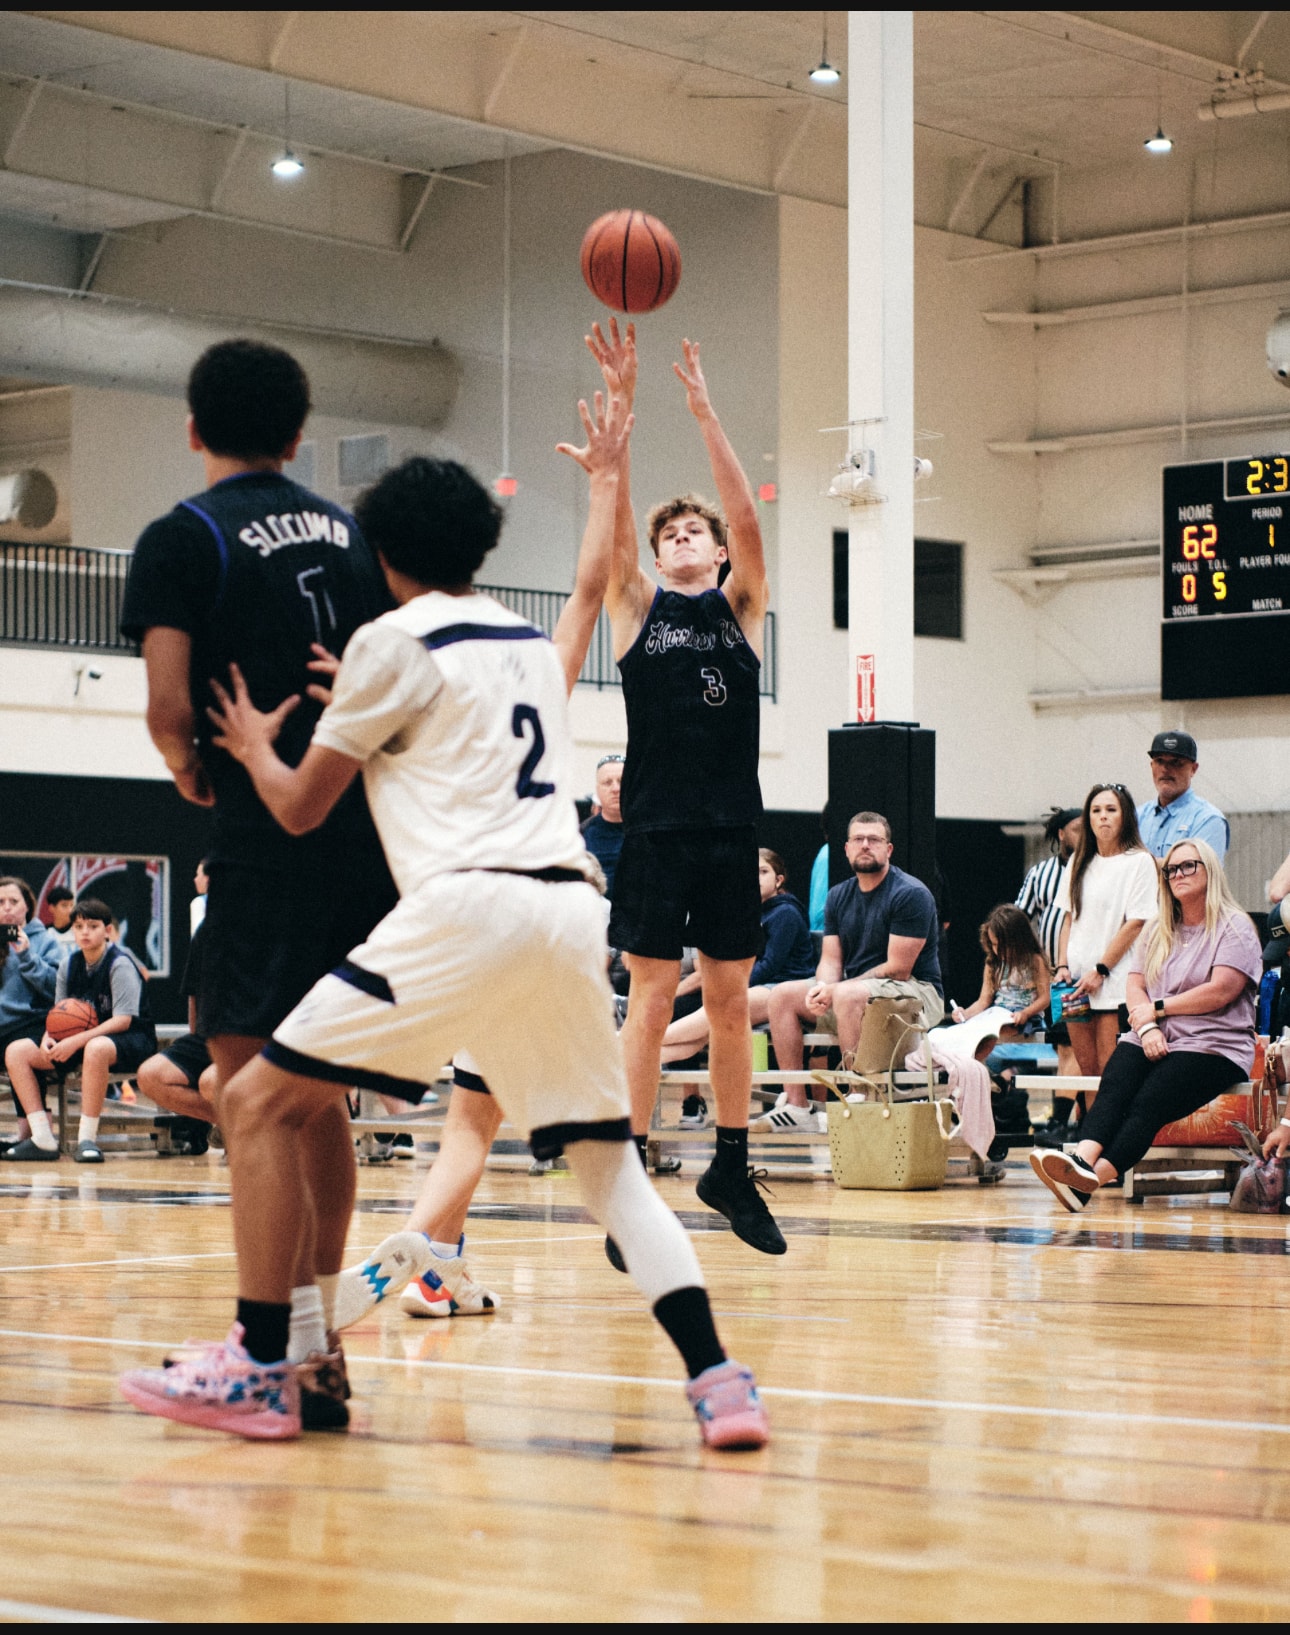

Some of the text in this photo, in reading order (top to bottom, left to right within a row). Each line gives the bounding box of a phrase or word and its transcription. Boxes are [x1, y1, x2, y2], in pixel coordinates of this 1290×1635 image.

[1178, 504, 1214, 522] HOME
[1251, 506, 1283, 519] PERIOD
[1182, 524, 1218, 560] 62
[1268, 523, 1275, 548] 1
[1171, 561, 1199, 573] FOULS
[1239, 555, 1272, 568] PLAYER
[1181, 573, 1197, 603] 0
[1212, 571, 1227, 601] 5
[1171, 604, 1199, 617] SCORE
[1251, 598, 1282, 611] MATCH
[701, 666, 727, 706] 3
[512, 703, 555, 799] 2
